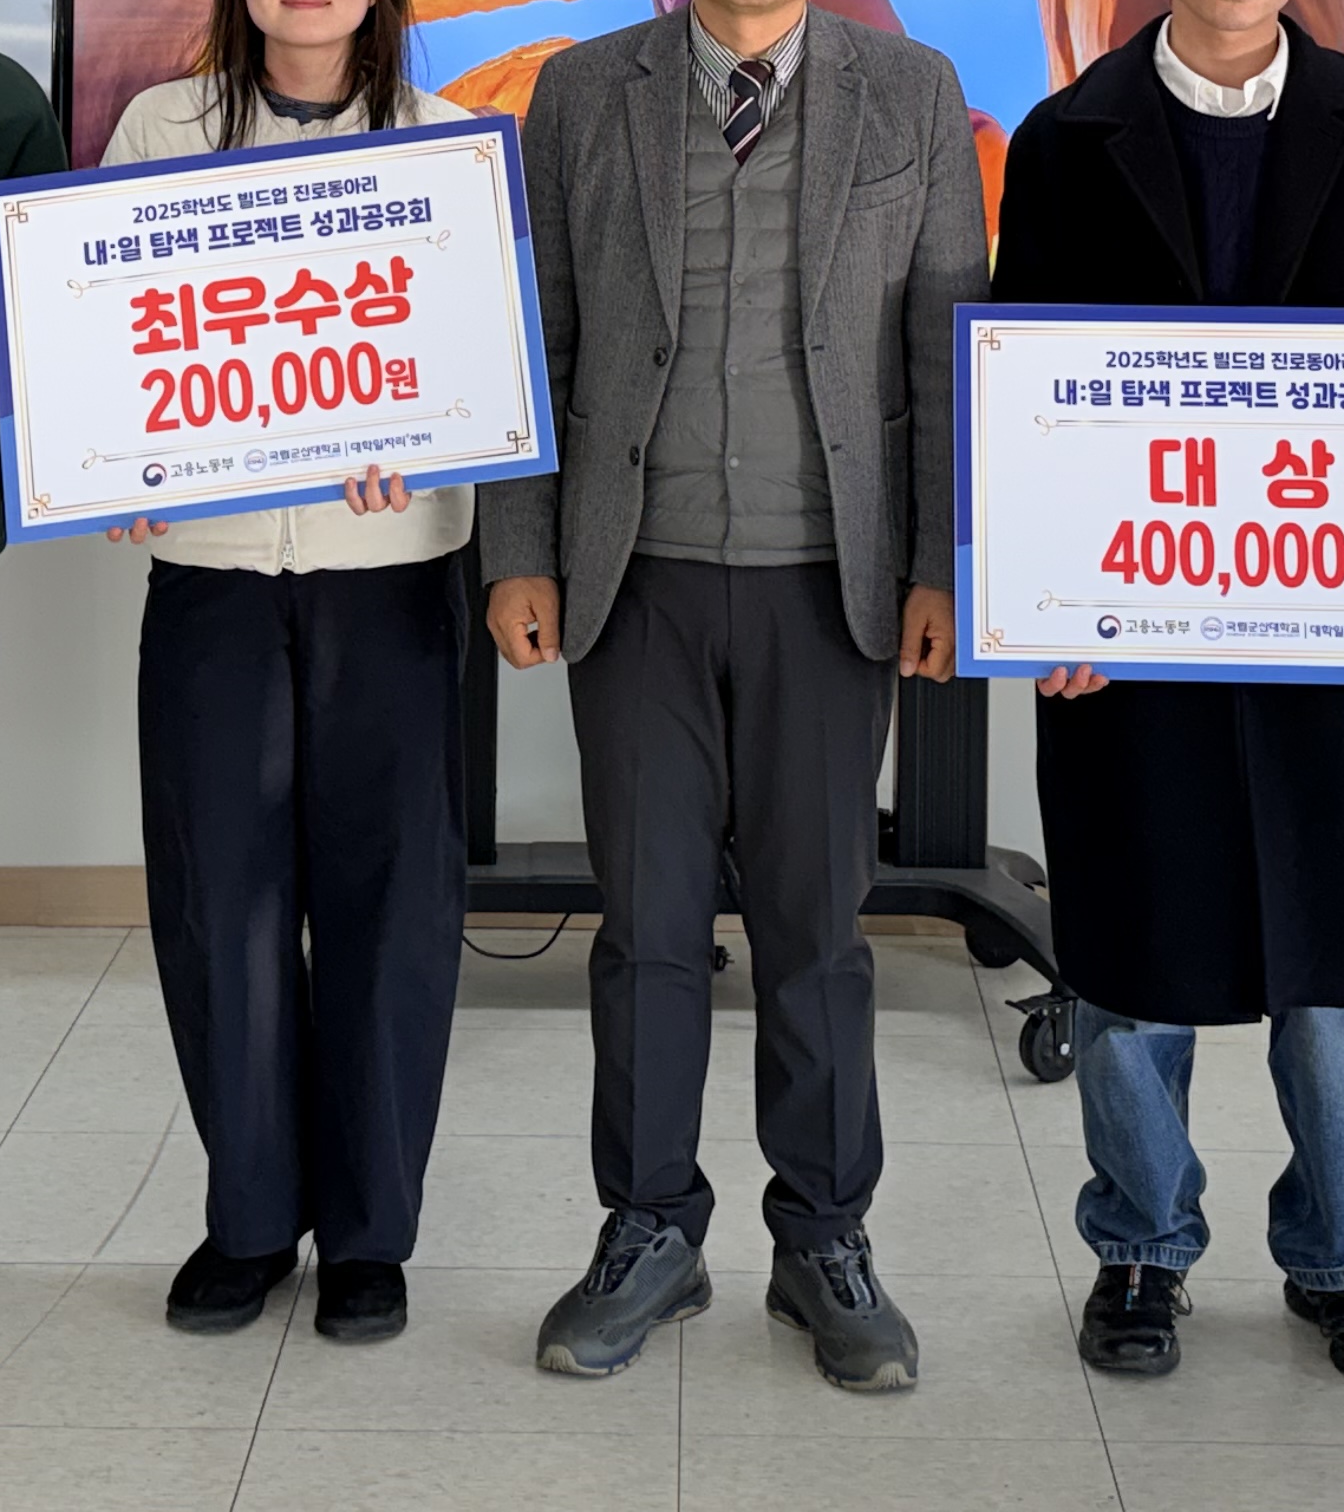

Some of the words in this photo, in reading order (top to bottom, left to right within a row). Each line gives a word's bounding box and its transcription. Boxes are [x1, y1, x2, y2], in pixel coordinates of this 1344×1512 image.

[132, 191, 233, 225] 2025학년도
[237, 185, 288, 213] 빌드업
[293, 175, 378, 206] 진로동아리
[83, 236, 142, 268] 내:일
[150, 226, 200, 259] 탐색
[207, 214, 304, 252] 프로젝트
[310, 197, 432, 240] 성과공유회
[129, 256, 414, 355] 최우수상
[1105, 350, 1209, 370] 2025학년도
[1213, 351, 1266, 371] 빌드업
[140, 341, 420, 434] 200,000원
[1053, 379, 1112, 407] 내:일
[1121, 380, 1172, 408] 탐색
[1179, 381, 1279, 410] 프로젝트
[170, 456, 235, 478] 고용노동부
[1125, 619, 1191, 635] 고용노동부
